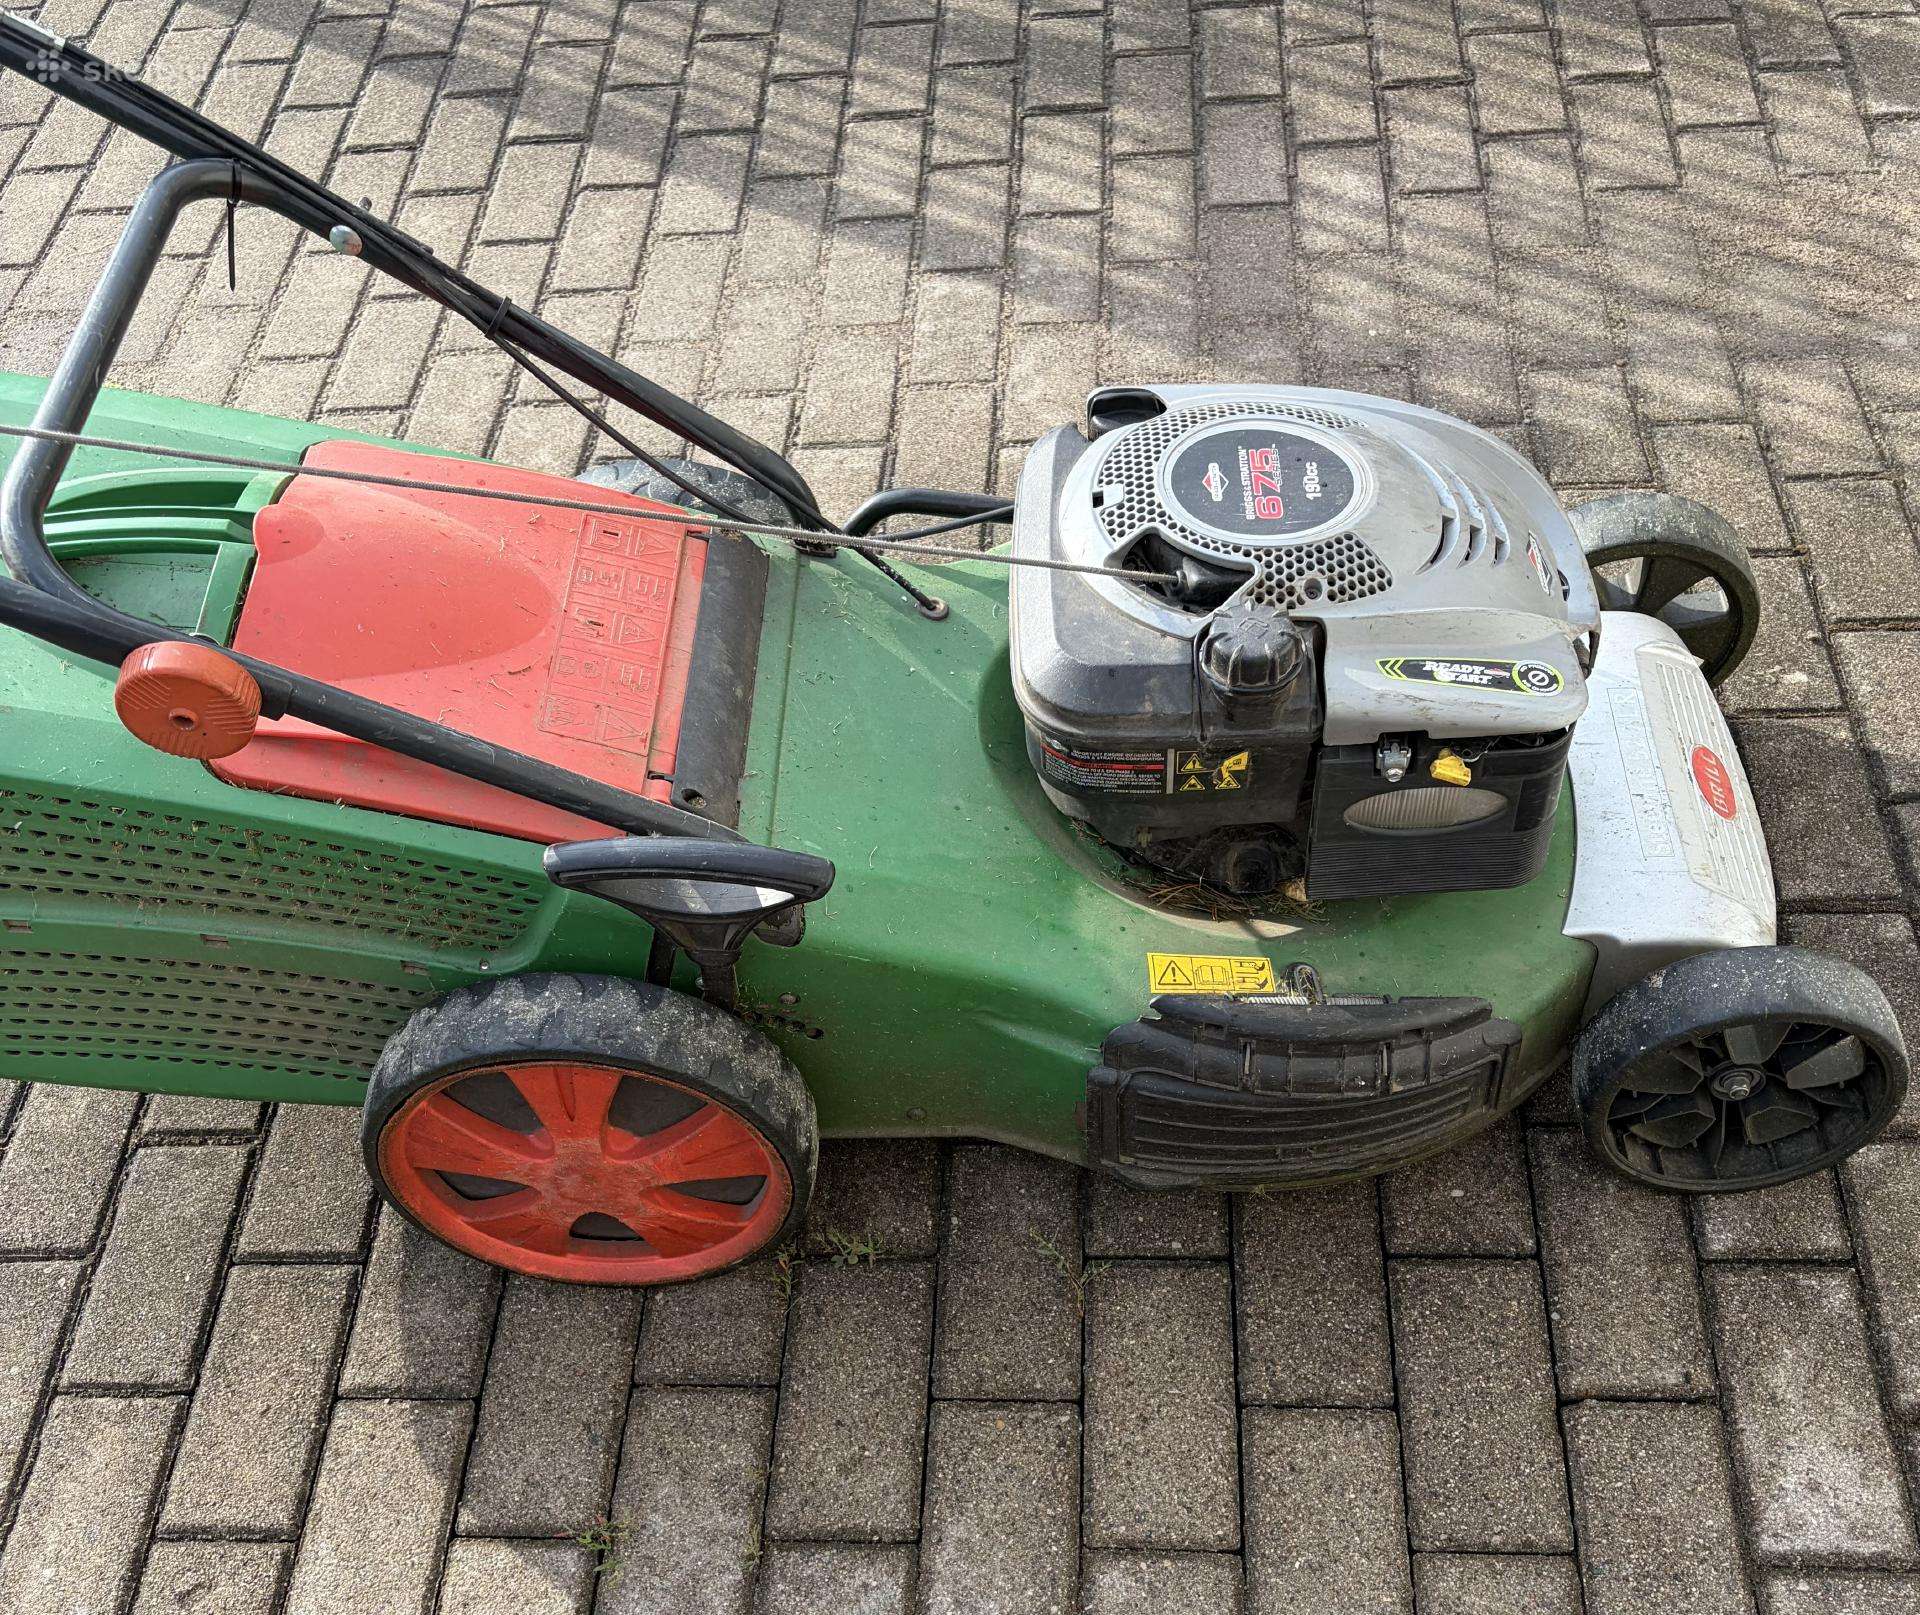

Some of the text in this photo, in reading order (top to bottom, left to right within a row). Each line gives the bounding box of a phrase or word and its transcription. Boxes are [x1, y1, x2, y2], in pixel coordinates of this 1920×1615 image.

[1249, 448, 1283, 519] 675
[1303, 461, 1321, 500] 190cc
[1422, 661, 1485, 675] READY
[1701, 752, 1729, 814] BRILL
